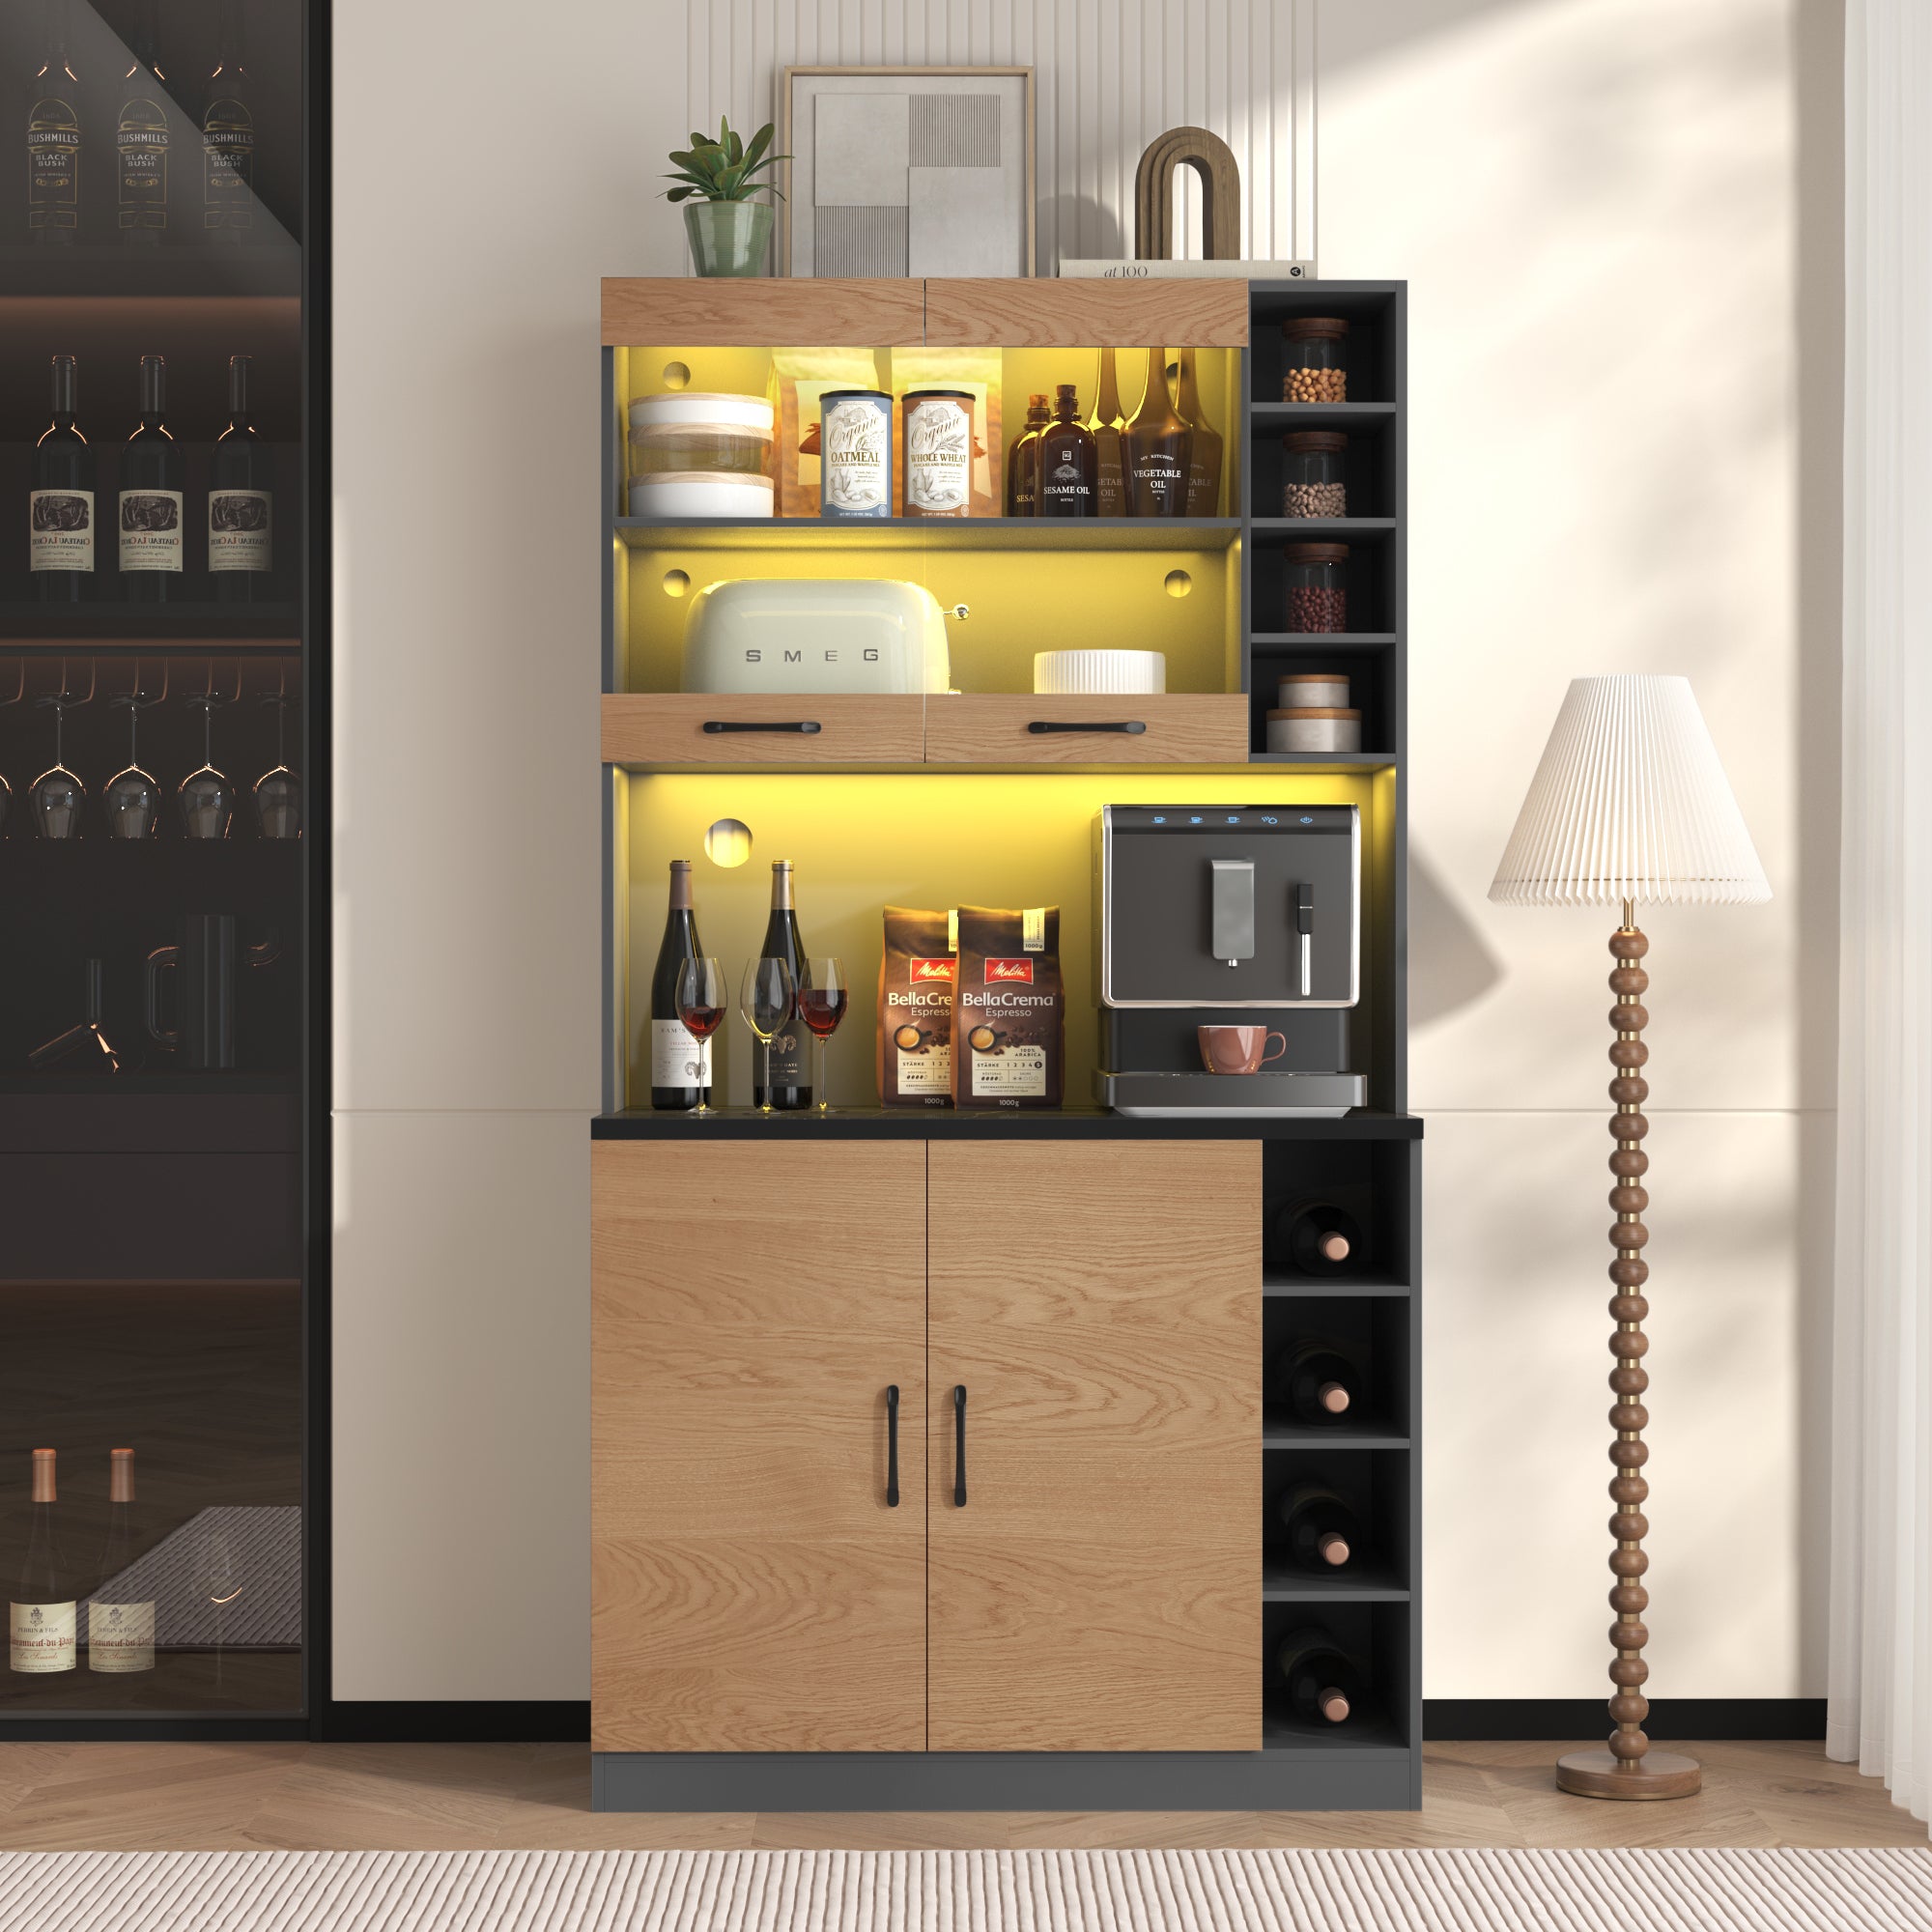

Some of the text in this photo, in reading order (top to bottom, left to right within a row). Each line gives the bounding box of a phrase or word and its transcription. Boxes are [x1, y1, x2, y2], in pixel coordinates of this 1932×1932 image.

[28, 133, 78, 144] BUSHMILLS
[117, 133, 168, 144] BUSHMILLS
[203, 133, 253, 144] BUSHMILLS
[1104, 266, 1149, 278] at 100
[830, 414, 879, 449] Organic
[911, 414, 961, 449] Organic
[831, 451, 881, 463] OATMEAL
[910, 453, 966, 464] WHOLE WHEAT
[1133, 469, 1181, 478] VEGETABLE
[1150, 480, 1166, 489] OIL
[1043, 486, 1091, 495] SESAME OIL
[915, 961, 952, 978] Melitta
[990, 961, 1027, 978] Melitta
[962, 992, 1053, 1007] BellaCrema
[985, 1008, 1032, 1018] Espresso
